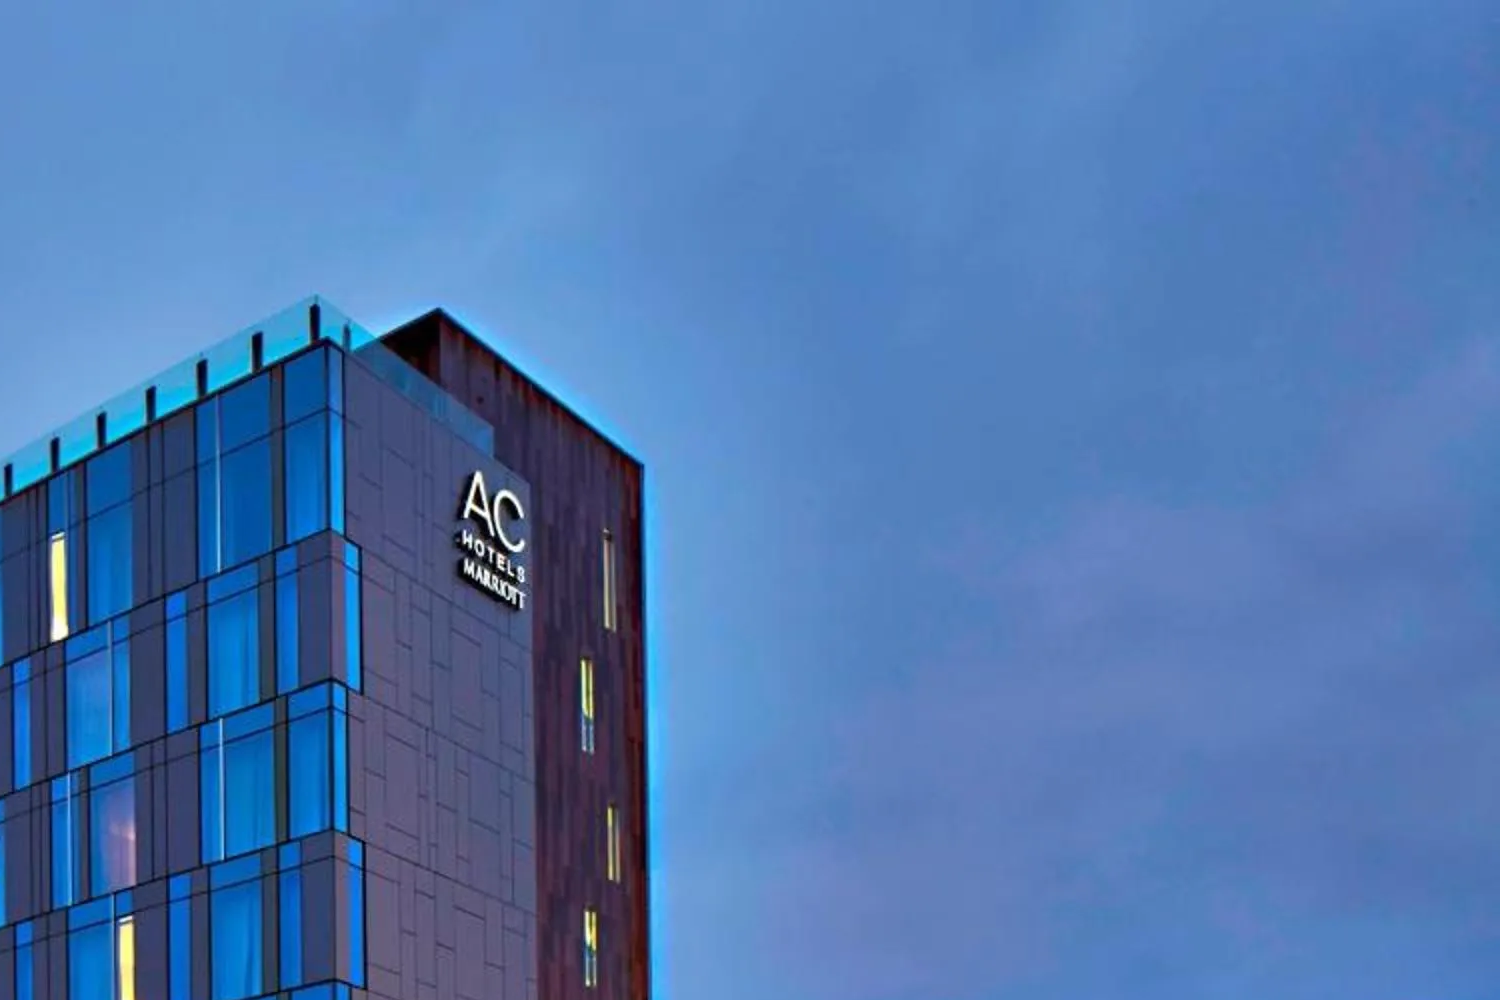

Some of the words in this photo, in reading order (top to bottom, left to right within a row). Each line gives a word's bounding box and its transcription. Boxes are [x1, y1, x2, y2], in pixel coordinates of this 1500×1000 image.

[463, 470, 525, 553] AC
[462, 529, 525, 583] HOTELS
[463, 557, 527, 609] MARRIOTT
